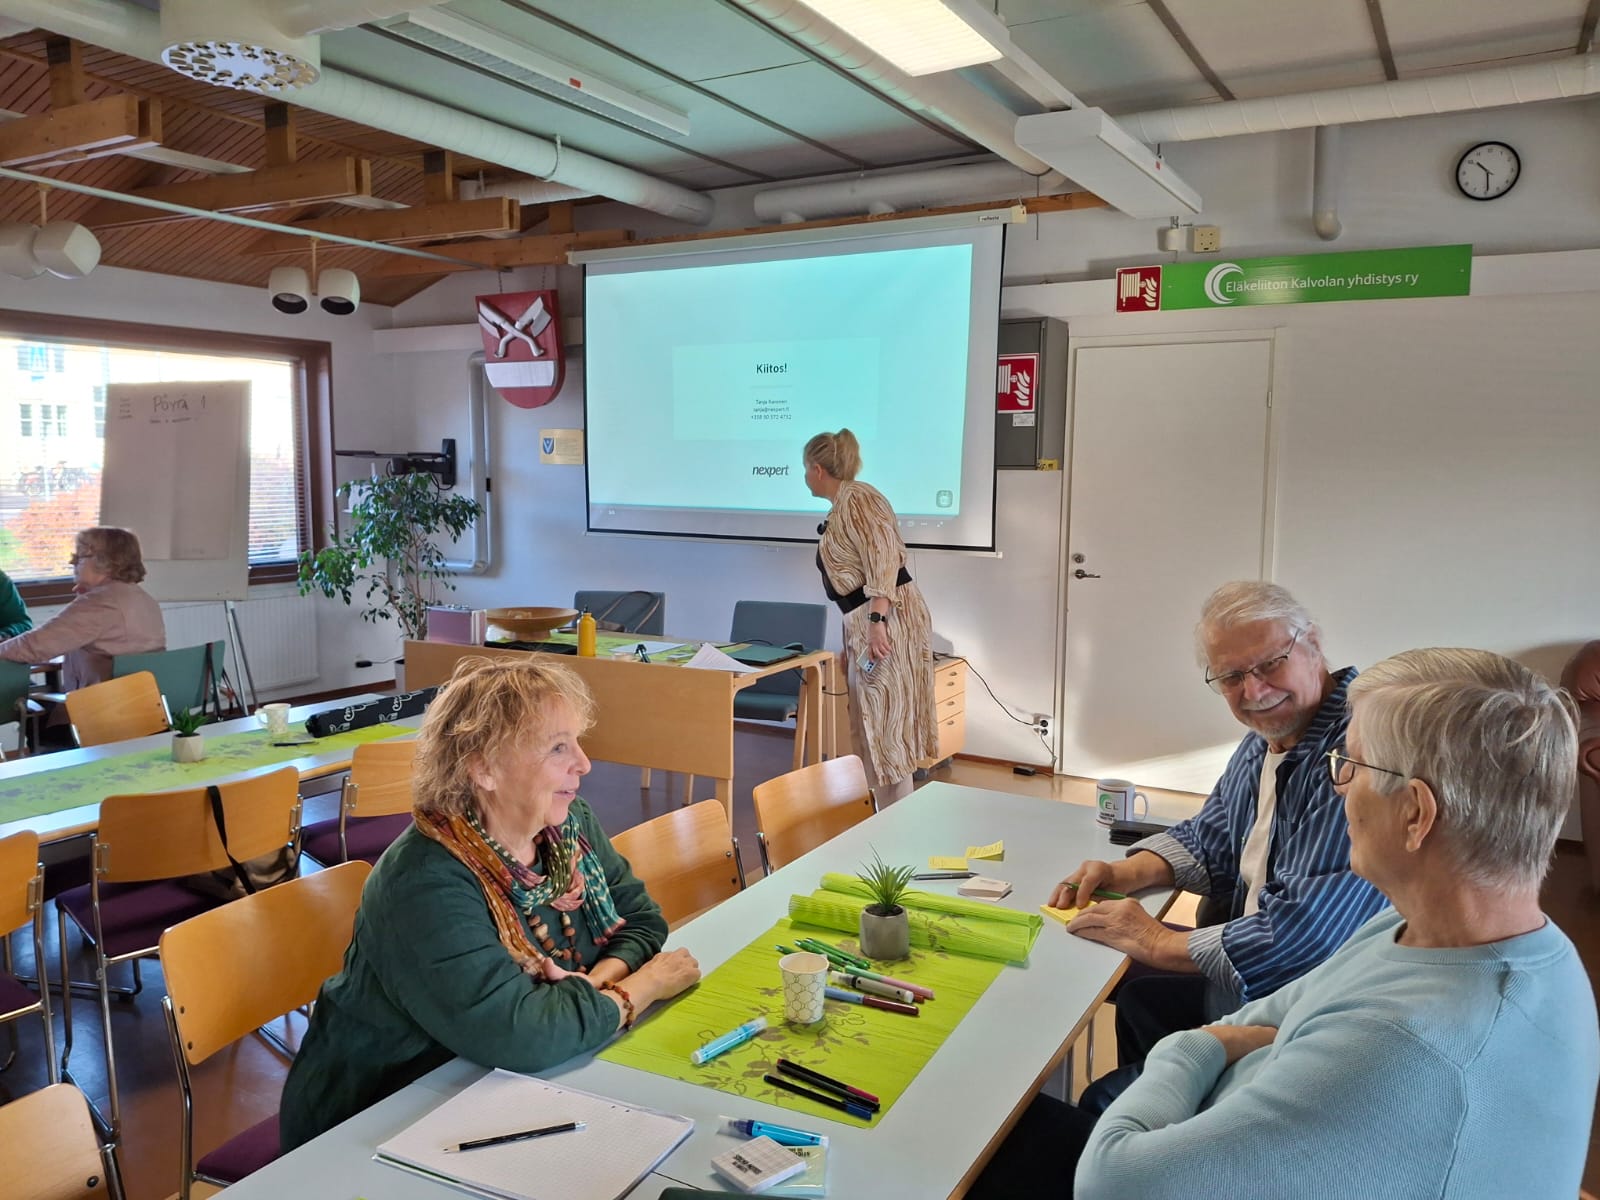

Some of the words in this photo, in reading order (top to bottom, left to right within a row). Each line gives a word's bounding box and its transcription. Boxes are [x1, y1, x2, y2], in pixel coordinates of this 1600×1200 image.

[1225, 280, 1288, 293] Eläkeliiton
[1291, 275, 1345, 289] Kalvolan
[1347, 273, 1402, 289] yhdistys
[1405, 273, 1419, 287] ry
[756, 362, 787, 374] Kiitos!
[752, 464, 790, 478] nexpert
[1105, 801, 1119, 811] EL
